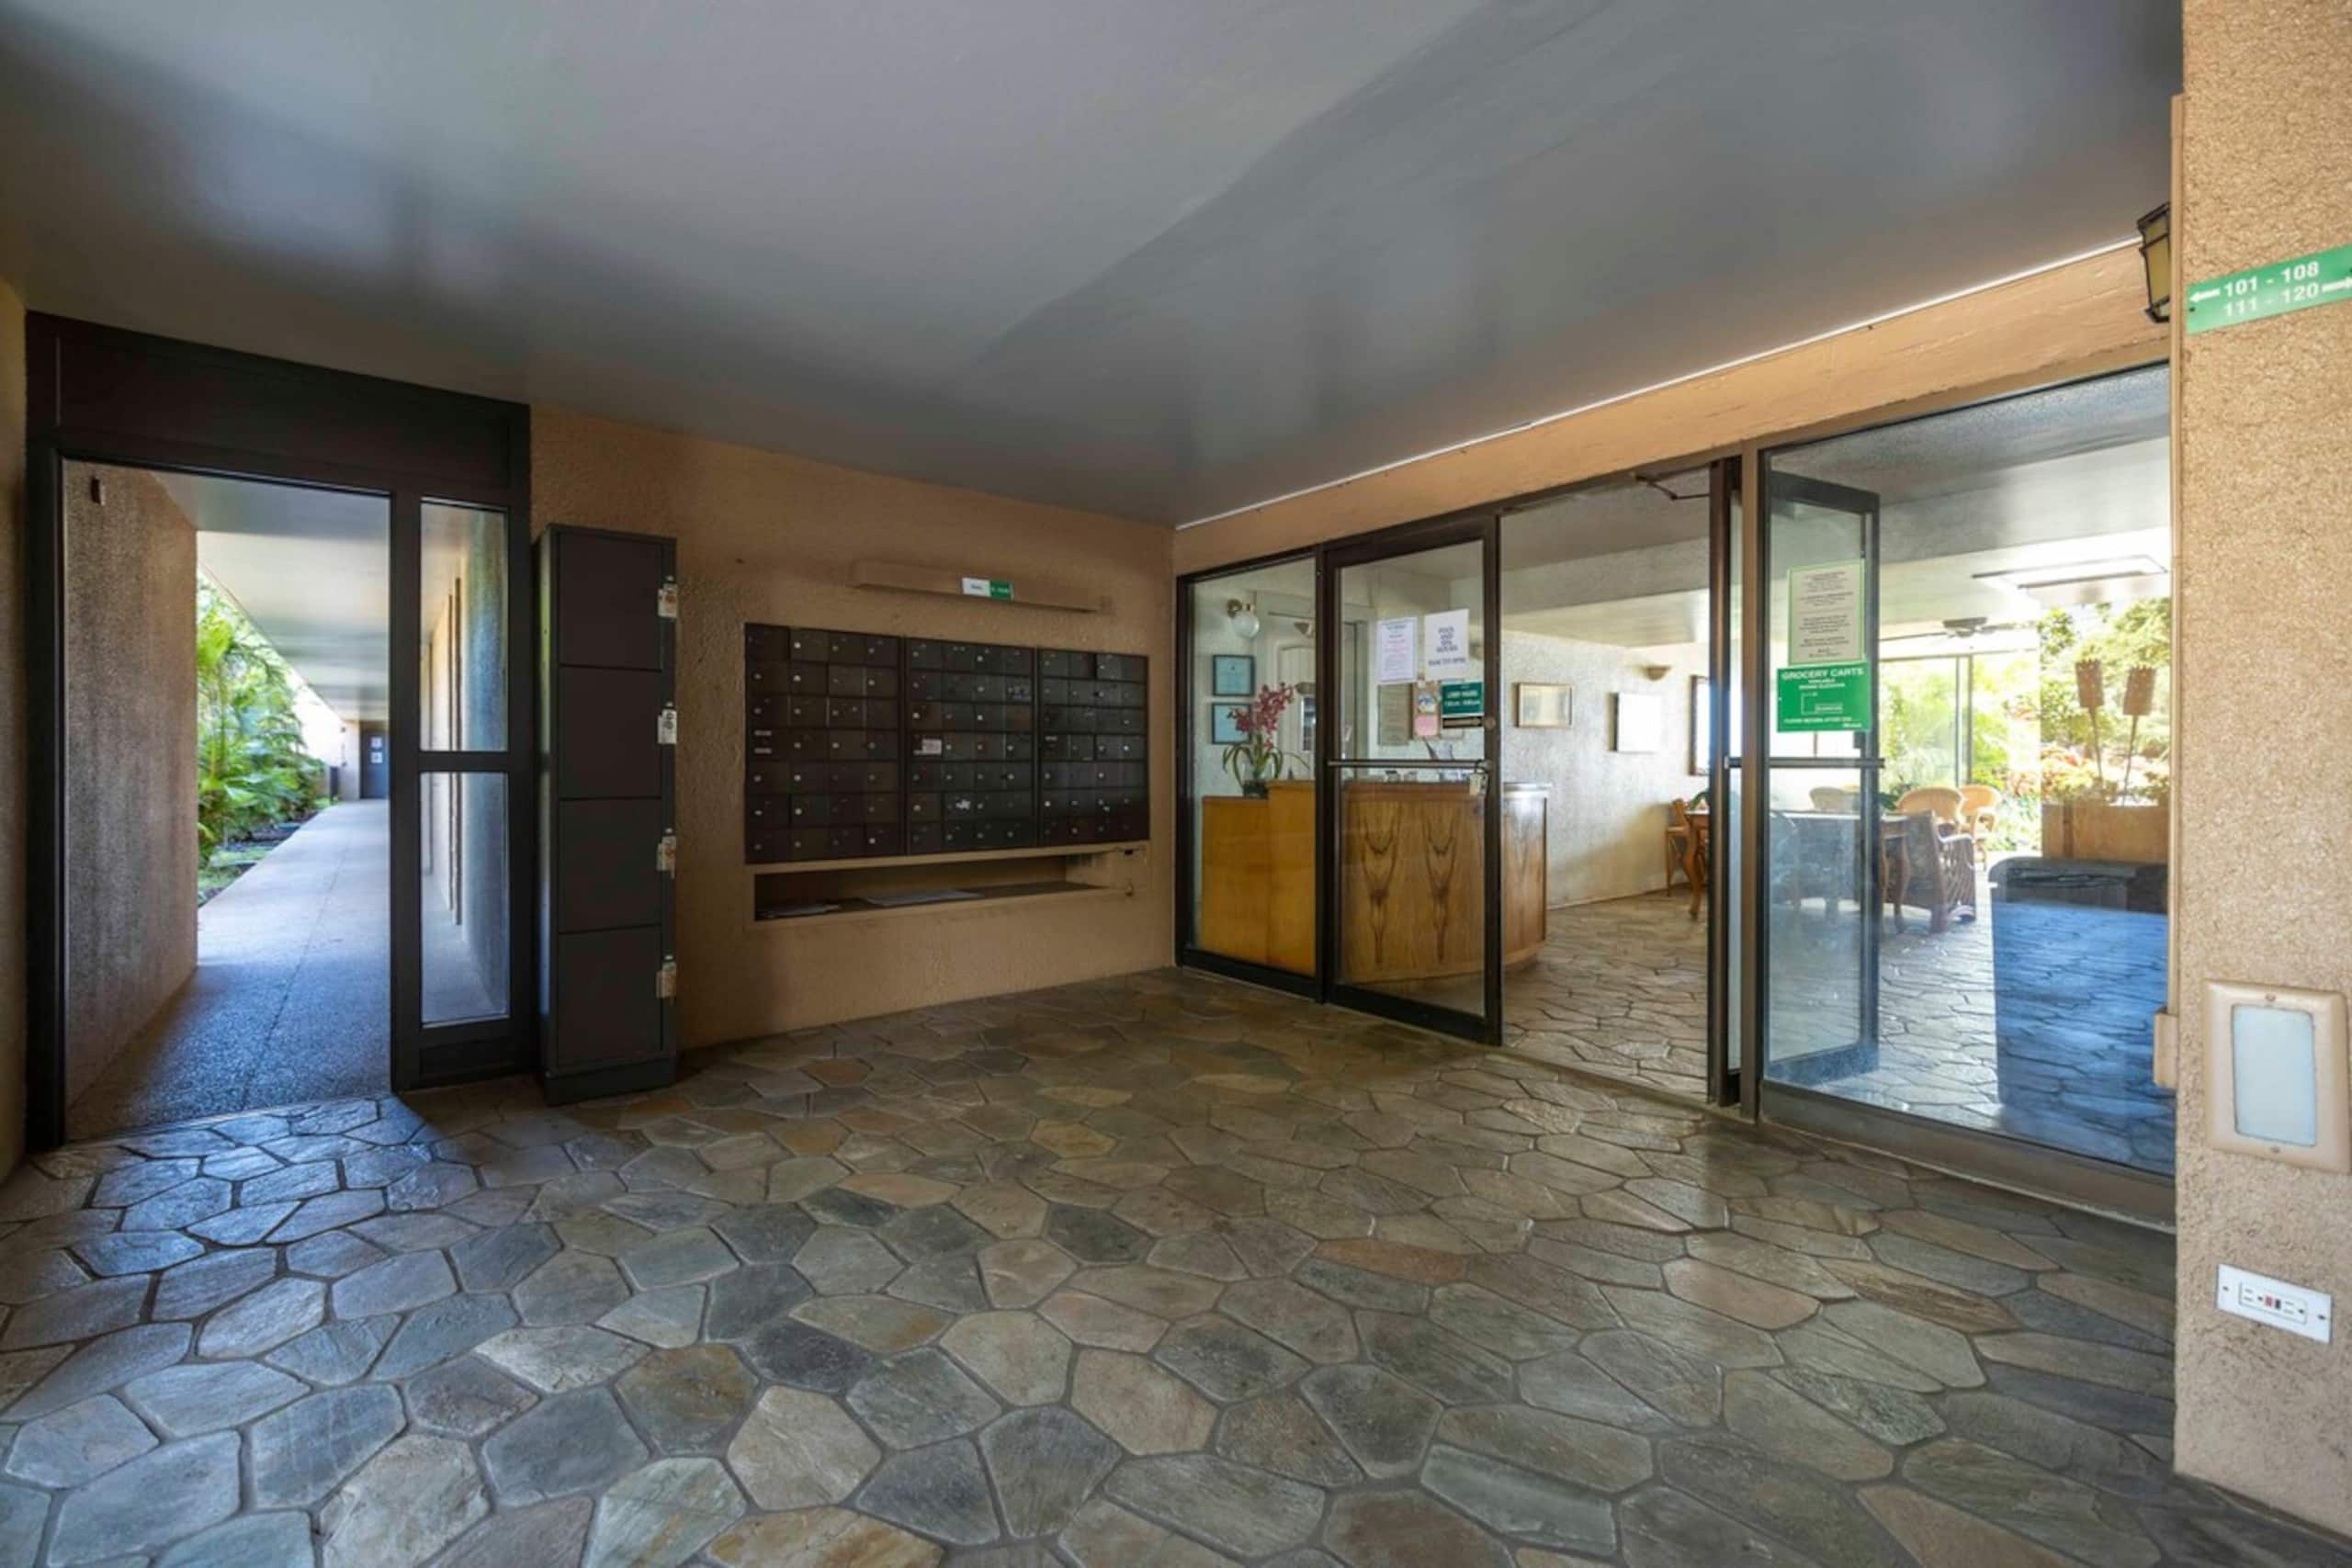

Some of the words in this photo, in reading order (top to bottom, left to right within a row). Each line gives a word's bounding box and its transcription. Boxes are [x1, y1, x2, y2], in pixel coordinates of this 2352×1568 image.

[2223, 276, 2258, 298] 101
[2281, 261, 2320, 283] 108
[2223, 297, 2258, 317] 111
[2281, 282, 2320, 304] 120
[1781, 669, 1829, 681] GROCERY
[1829, 667, 1865, 678] CARTS
